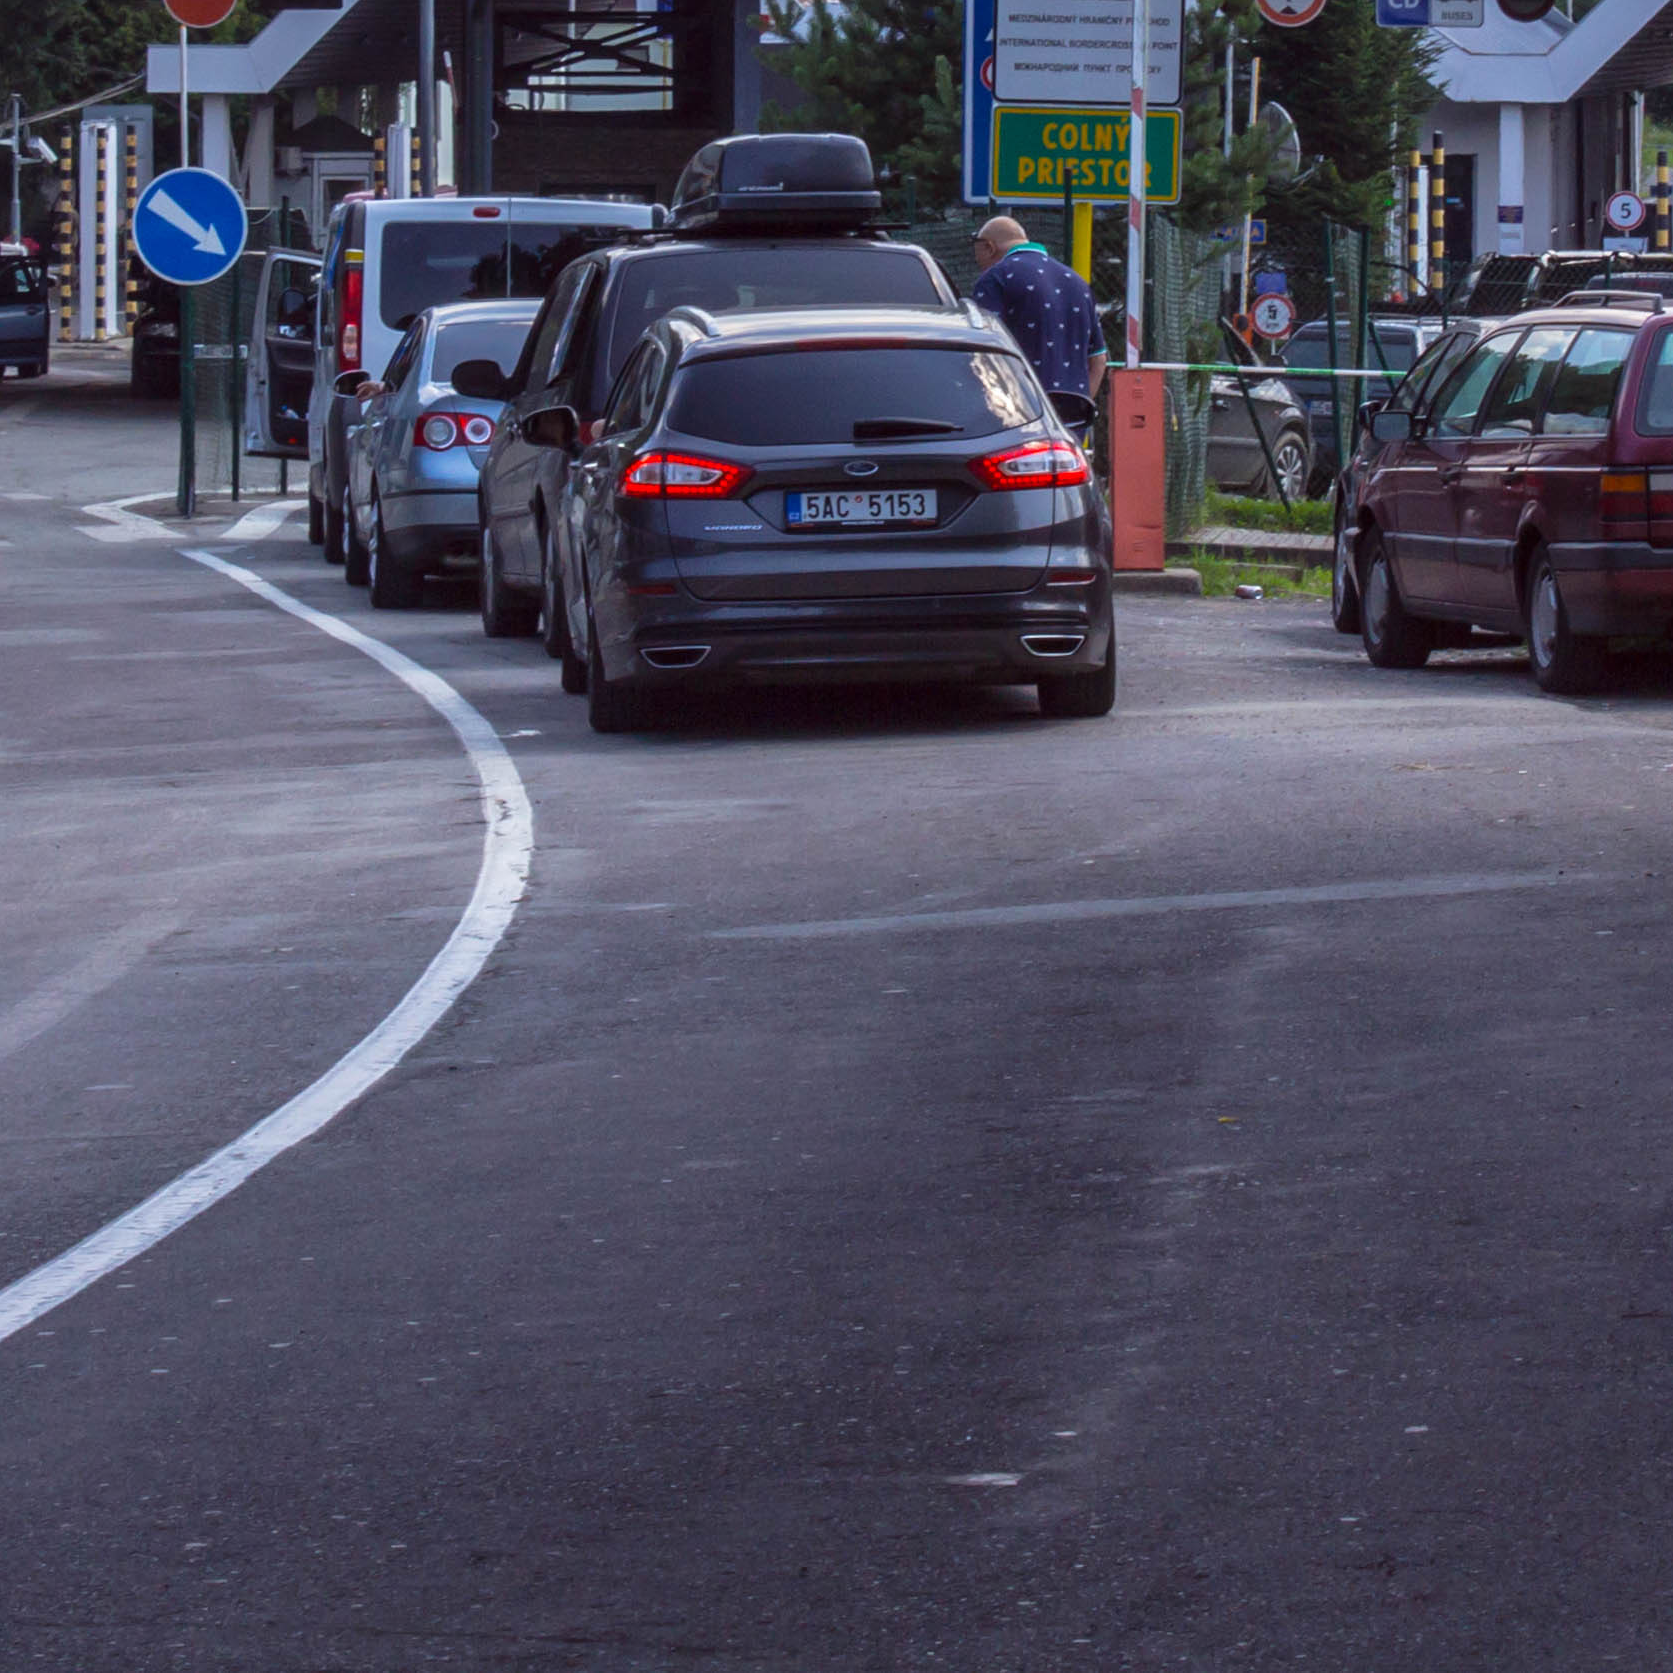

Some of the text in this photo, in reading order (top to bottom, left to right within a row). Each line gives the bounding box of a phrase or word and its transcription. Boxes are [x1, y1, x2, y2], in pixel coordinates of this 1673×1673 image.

[1041, 117, 1131, 152] COLNÝ
[1620, 202, 1631, 219] 5
[1267, 305, 1278, 320] 5
[806, 493, 926, 519] 5AC 5153
